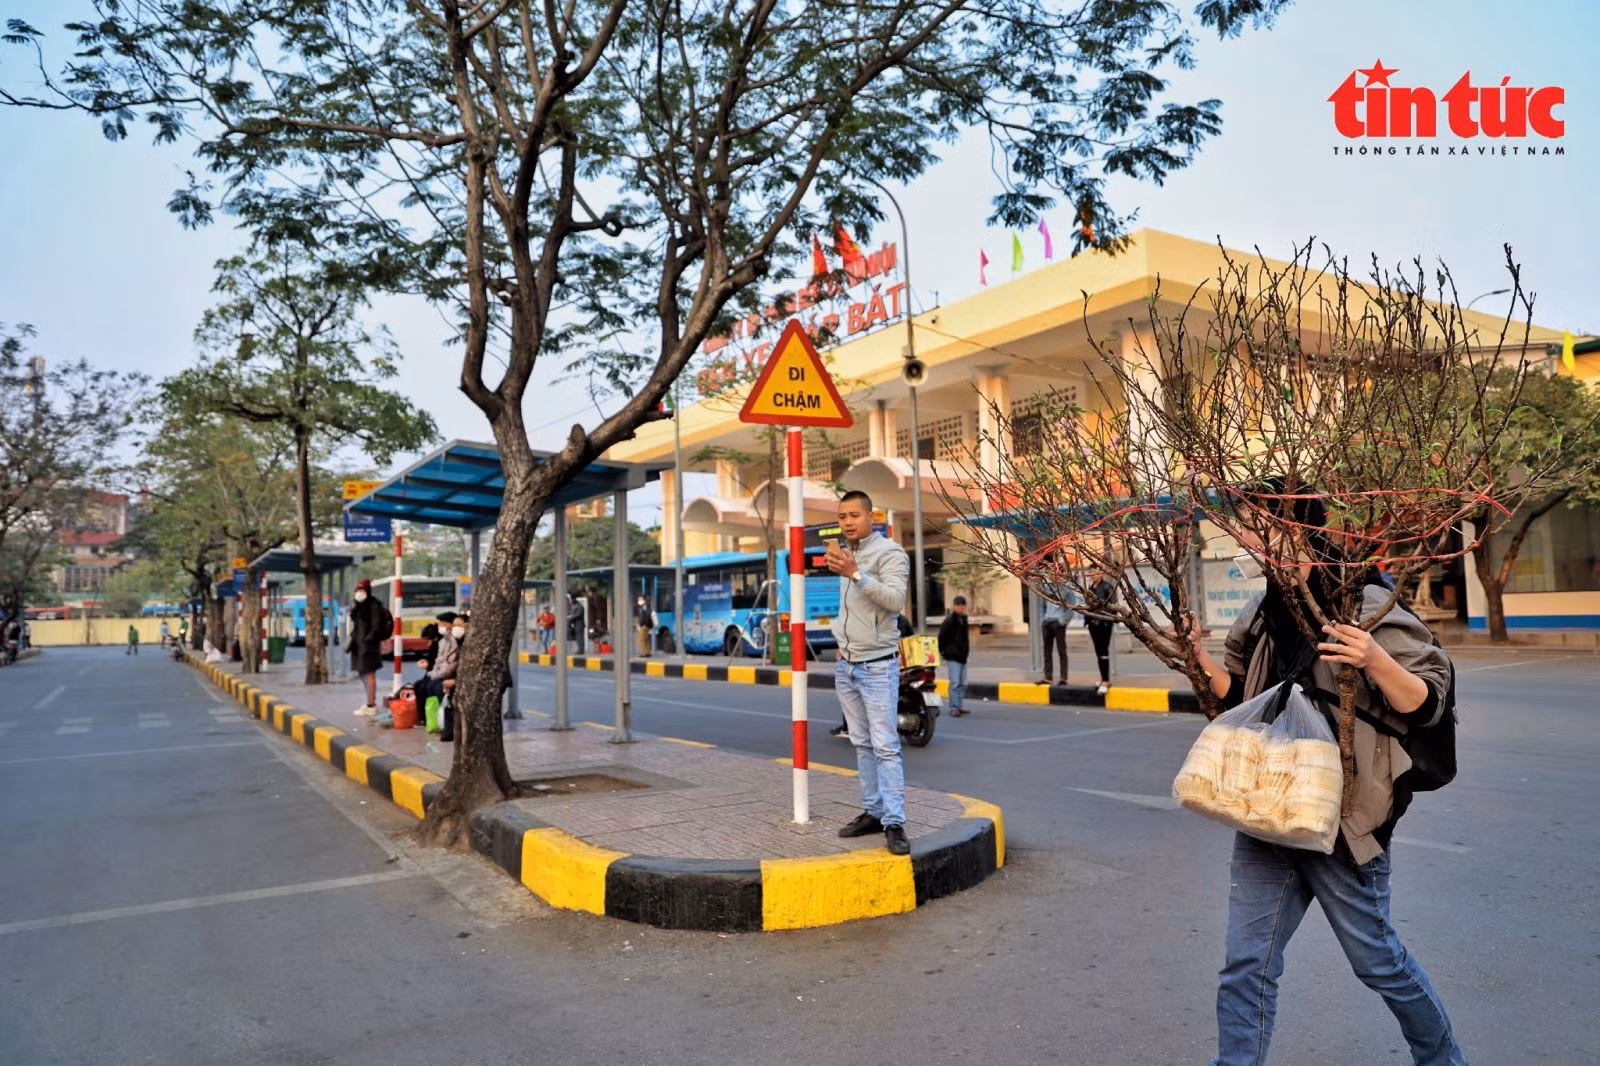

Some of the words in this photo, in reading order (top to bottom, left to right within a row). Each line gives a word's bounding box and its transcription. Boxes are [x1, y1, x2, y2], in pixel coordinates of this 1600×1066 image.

[848, 282, 908, 335] BÁT
[788, 366, 805, 381] ĐI
[773, 390, 821, 412] CHẬM
